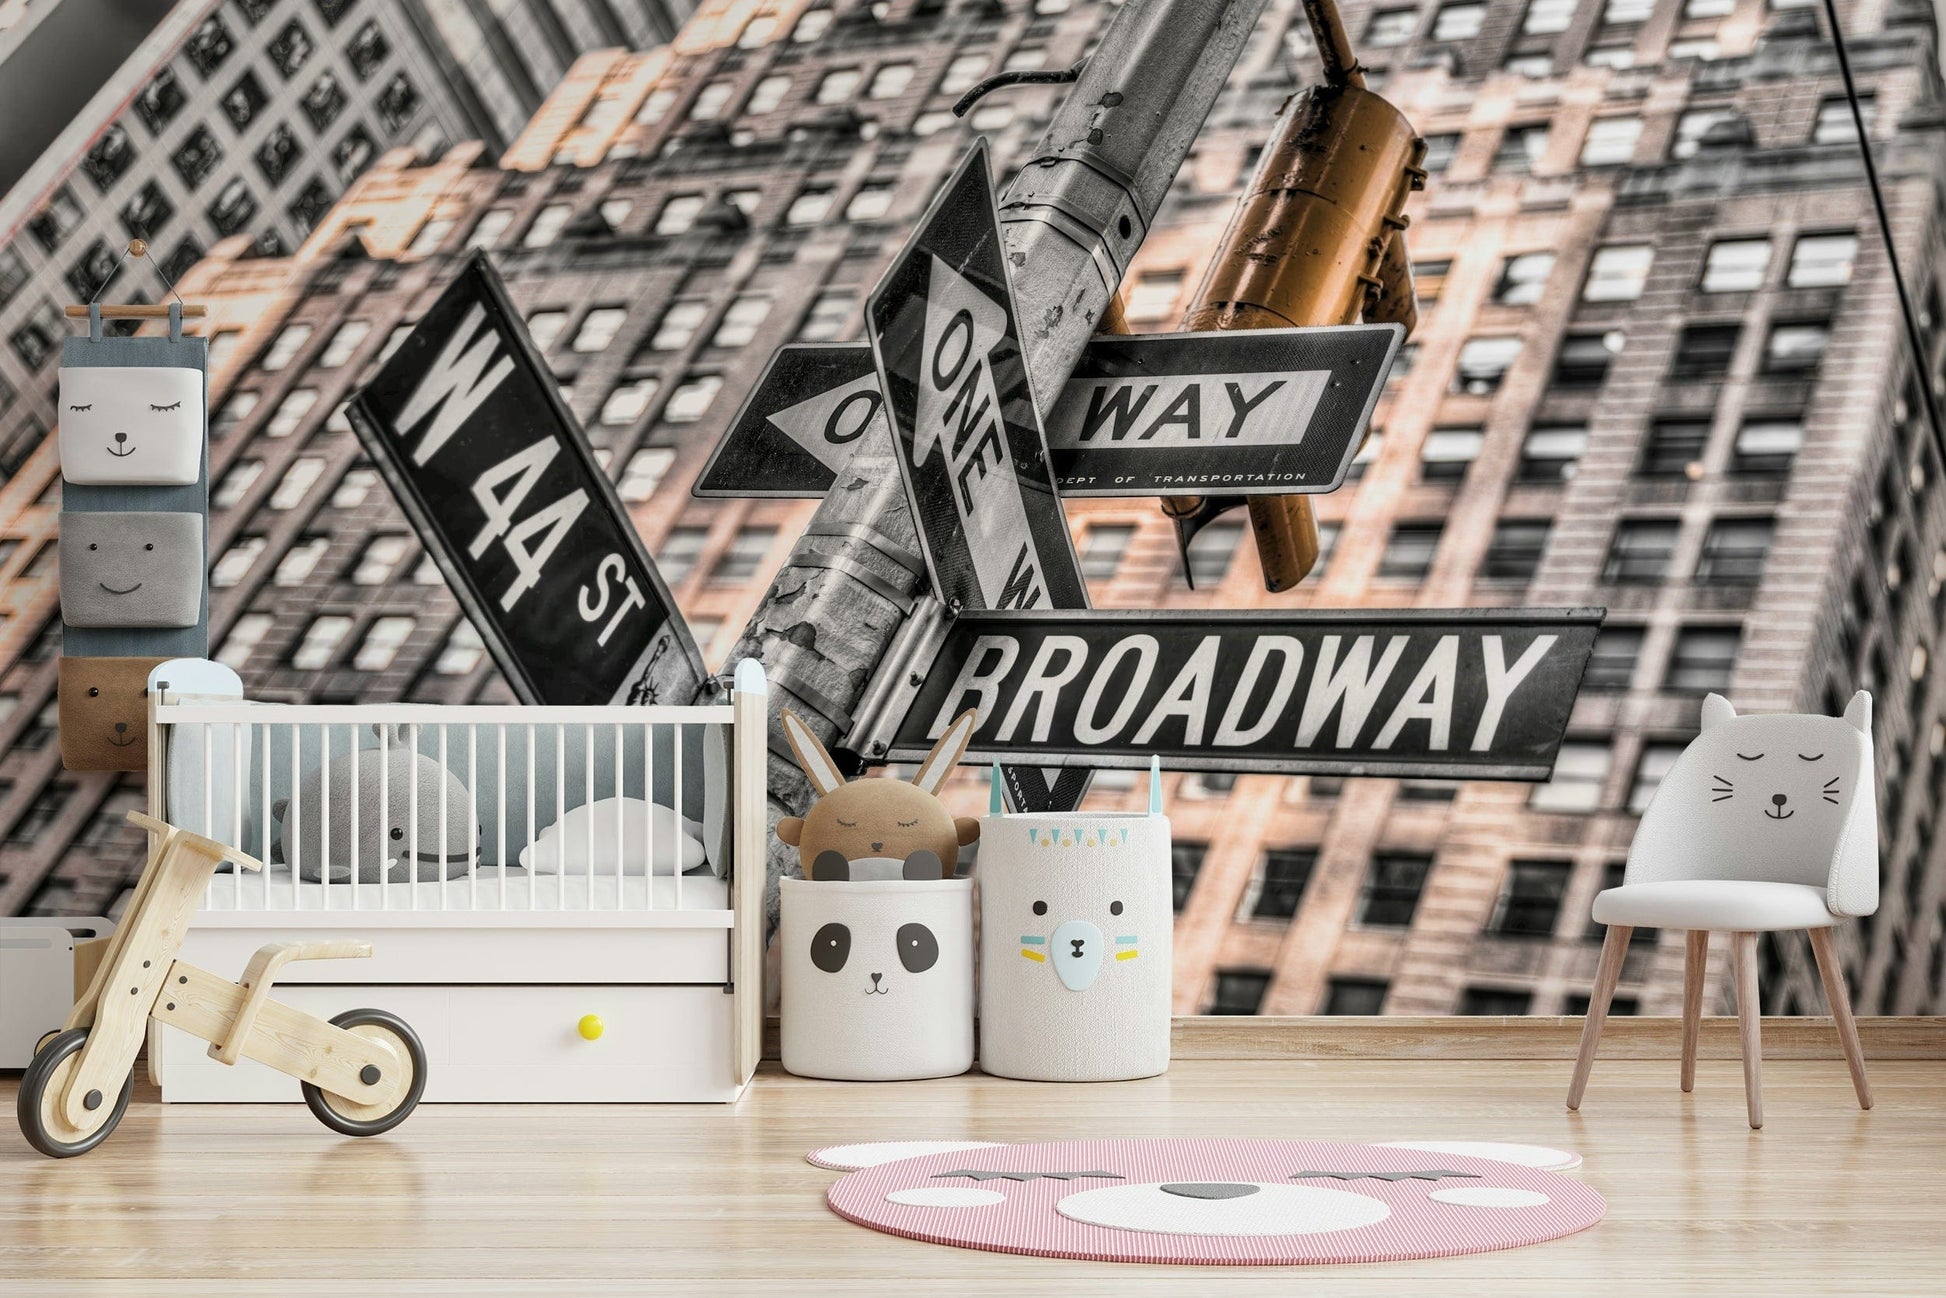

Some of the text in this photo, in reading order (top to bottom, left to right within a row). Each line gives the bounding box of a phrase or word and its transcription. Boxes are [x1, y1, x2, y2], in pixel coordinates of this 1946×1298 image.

[932, 308, 1003, 517] ONE
[1078, 380, 1288, 441] WAY
[394, 301, 646, 647] W 44 ST
[1056, 472, 1307, 484] DEPT OF TRANSPORTATION
[926, 634, 1559, 752] BROADWAY
